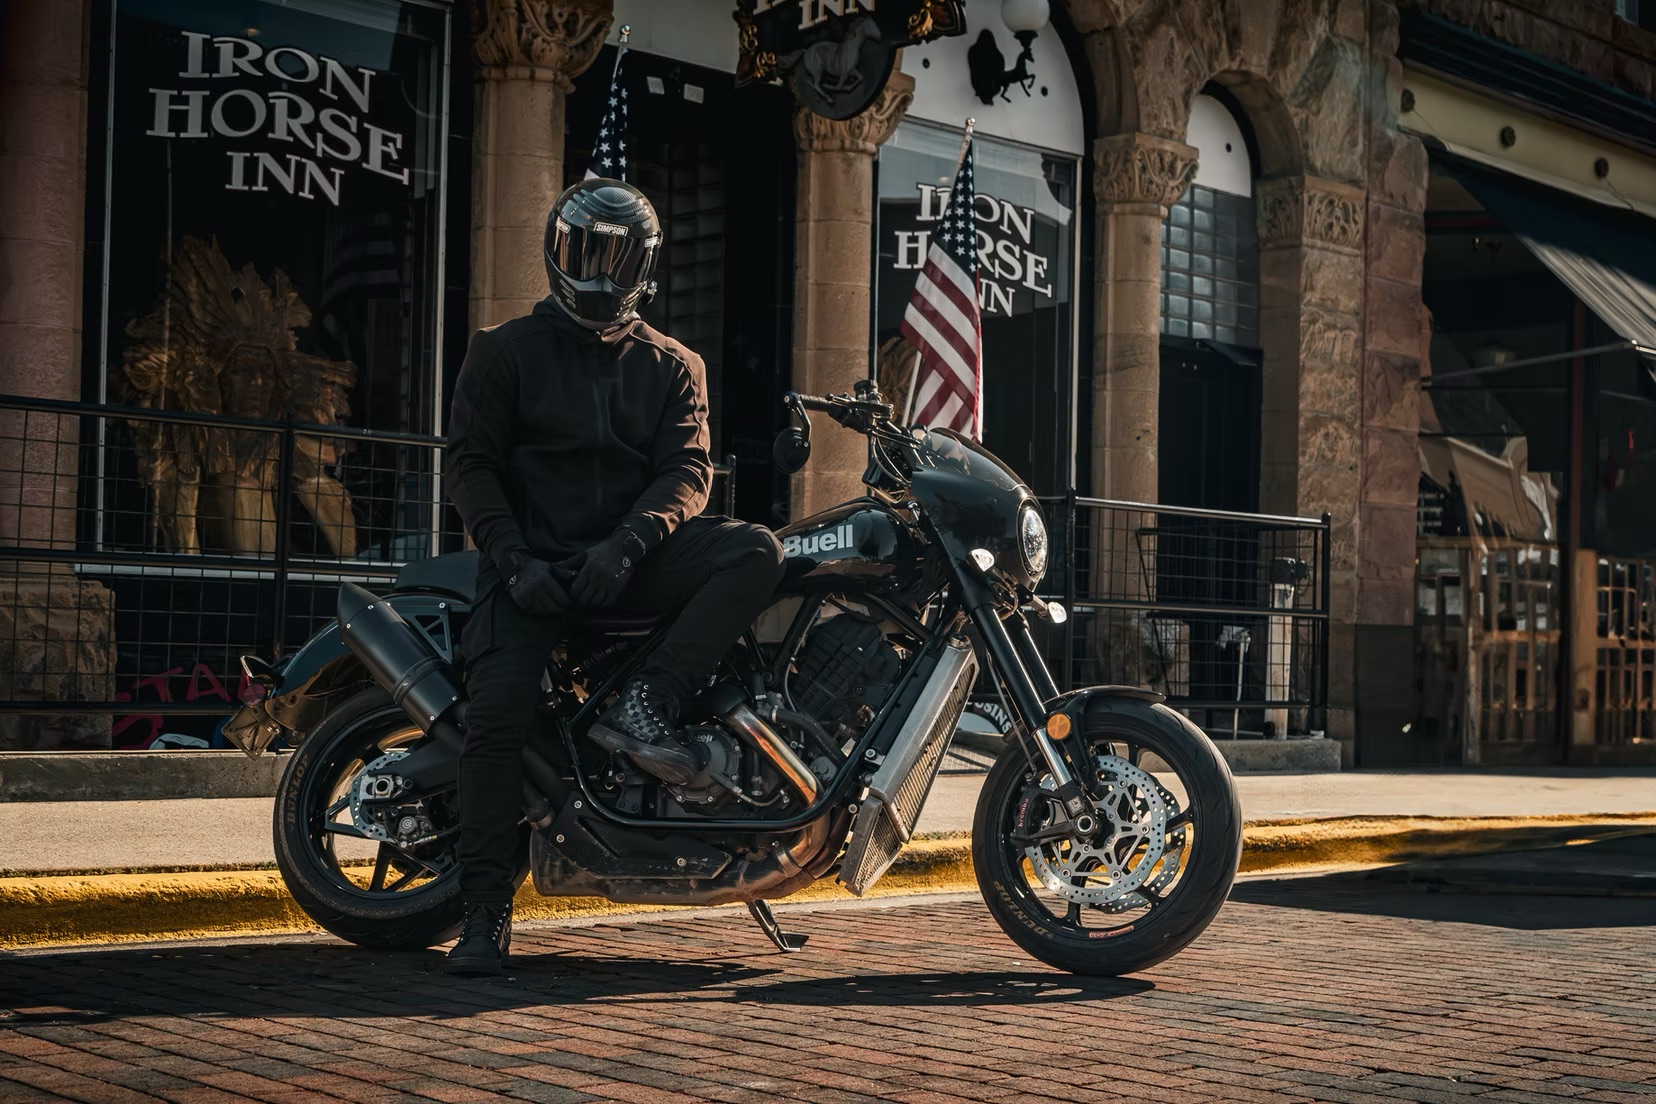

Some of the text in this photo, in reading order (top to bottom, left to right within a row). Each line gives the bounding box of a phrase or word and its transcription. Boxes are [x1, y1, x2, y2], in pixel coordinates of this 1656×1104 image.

[179, 31, 376, 114] IRON
[146, 87, 409, 186] HORSE
[225, 151, 345, 206] INN
[595, 223, 627, 236] SIMPSON
[893, 231, 1052, 298] HRSE
[783, 524, 854, 559] Buell
[993, 880, 1048, 937] DUNLOP
